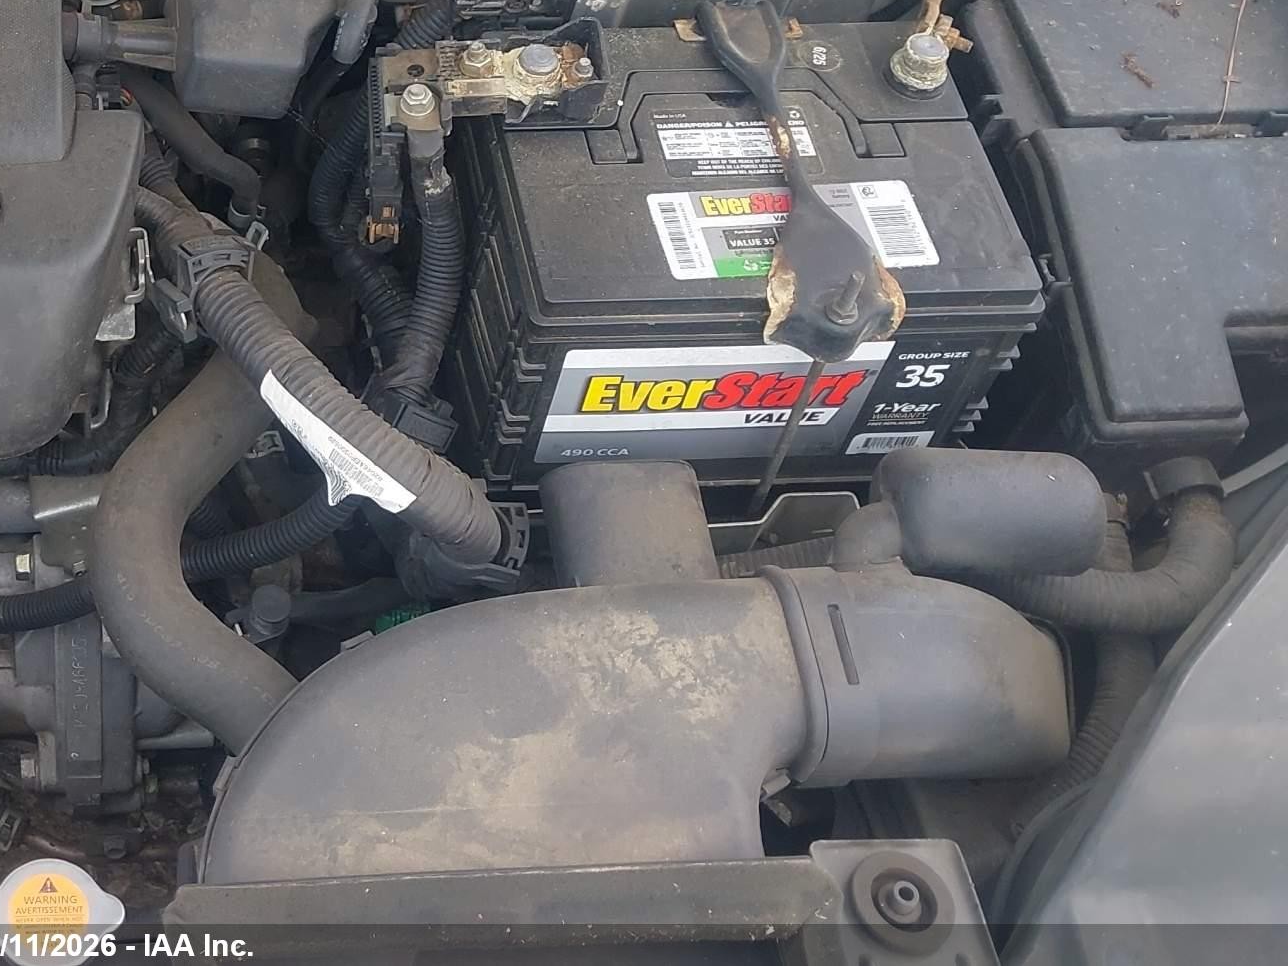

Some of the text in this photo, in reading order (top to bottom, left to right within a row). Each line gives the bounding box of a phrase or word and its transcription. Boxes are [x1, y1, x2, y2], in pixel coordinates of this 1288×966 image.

[812, 46, 828, 66] 6/25
[699, 192, 791, 217] EverSta
[729, 237, 775, 247] VALUE 35
[898, 351, 971, 360] GROUP SIZE
[895, 364, 951, 388] 35
[578, 369, 869, 415] EverStart
[874, 402, 942, 413] 1-Year
[872, 412, 929, 420] WARRANTY
[561, 447, 630, 457] 490 CCA
[23, 895, 78, 905] WARNING
[15, 906, 83, 914] AVERTISSEMENT
